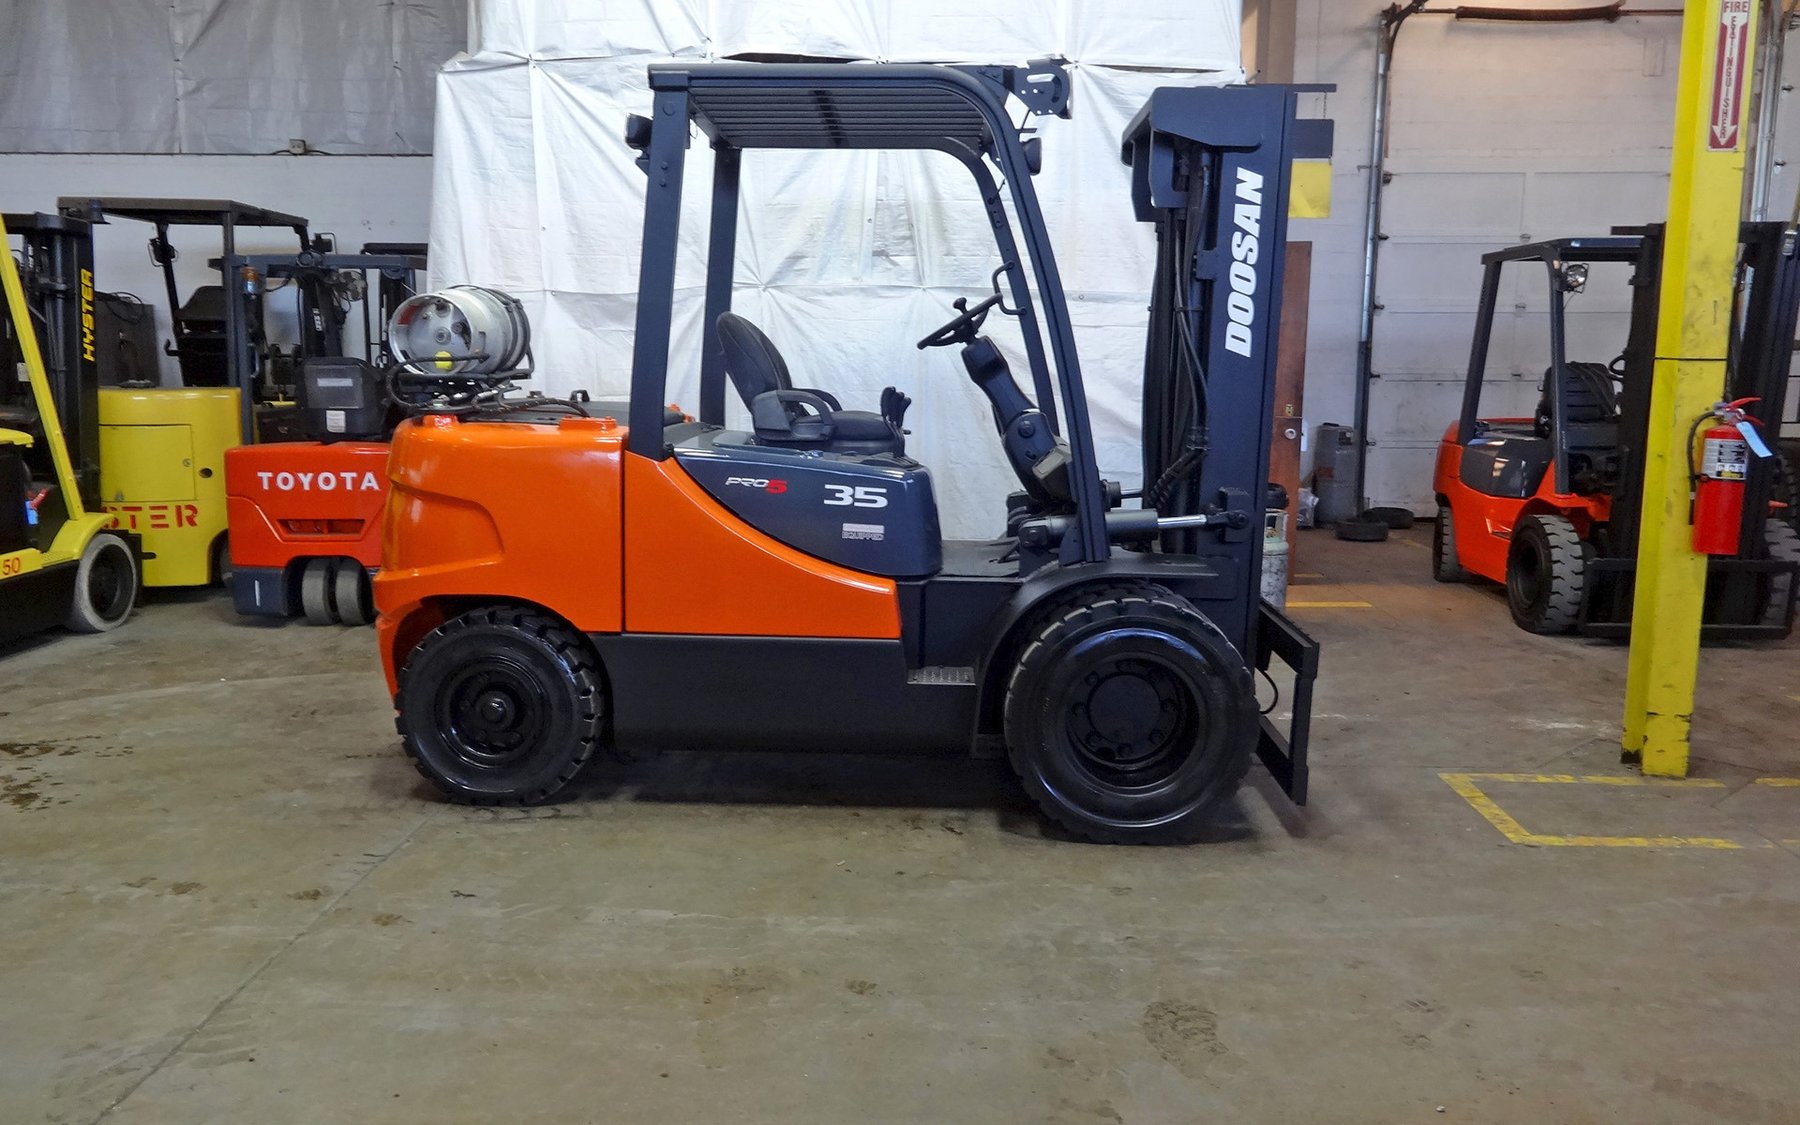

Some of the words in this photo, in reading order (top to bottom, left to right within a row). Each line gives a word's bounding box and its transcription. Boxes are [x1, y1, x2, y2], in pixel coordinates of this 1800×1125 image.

[1723, 1, 1748, 12] FIRE
[1225, 167, 1264, 358] DOOSAN
[80, 268, 95, 362] HYSTER
[257, 471, 381, 491] TOYOTA
[824, 484, 888, 508] 35
[2, 557, 21, 576] 50
